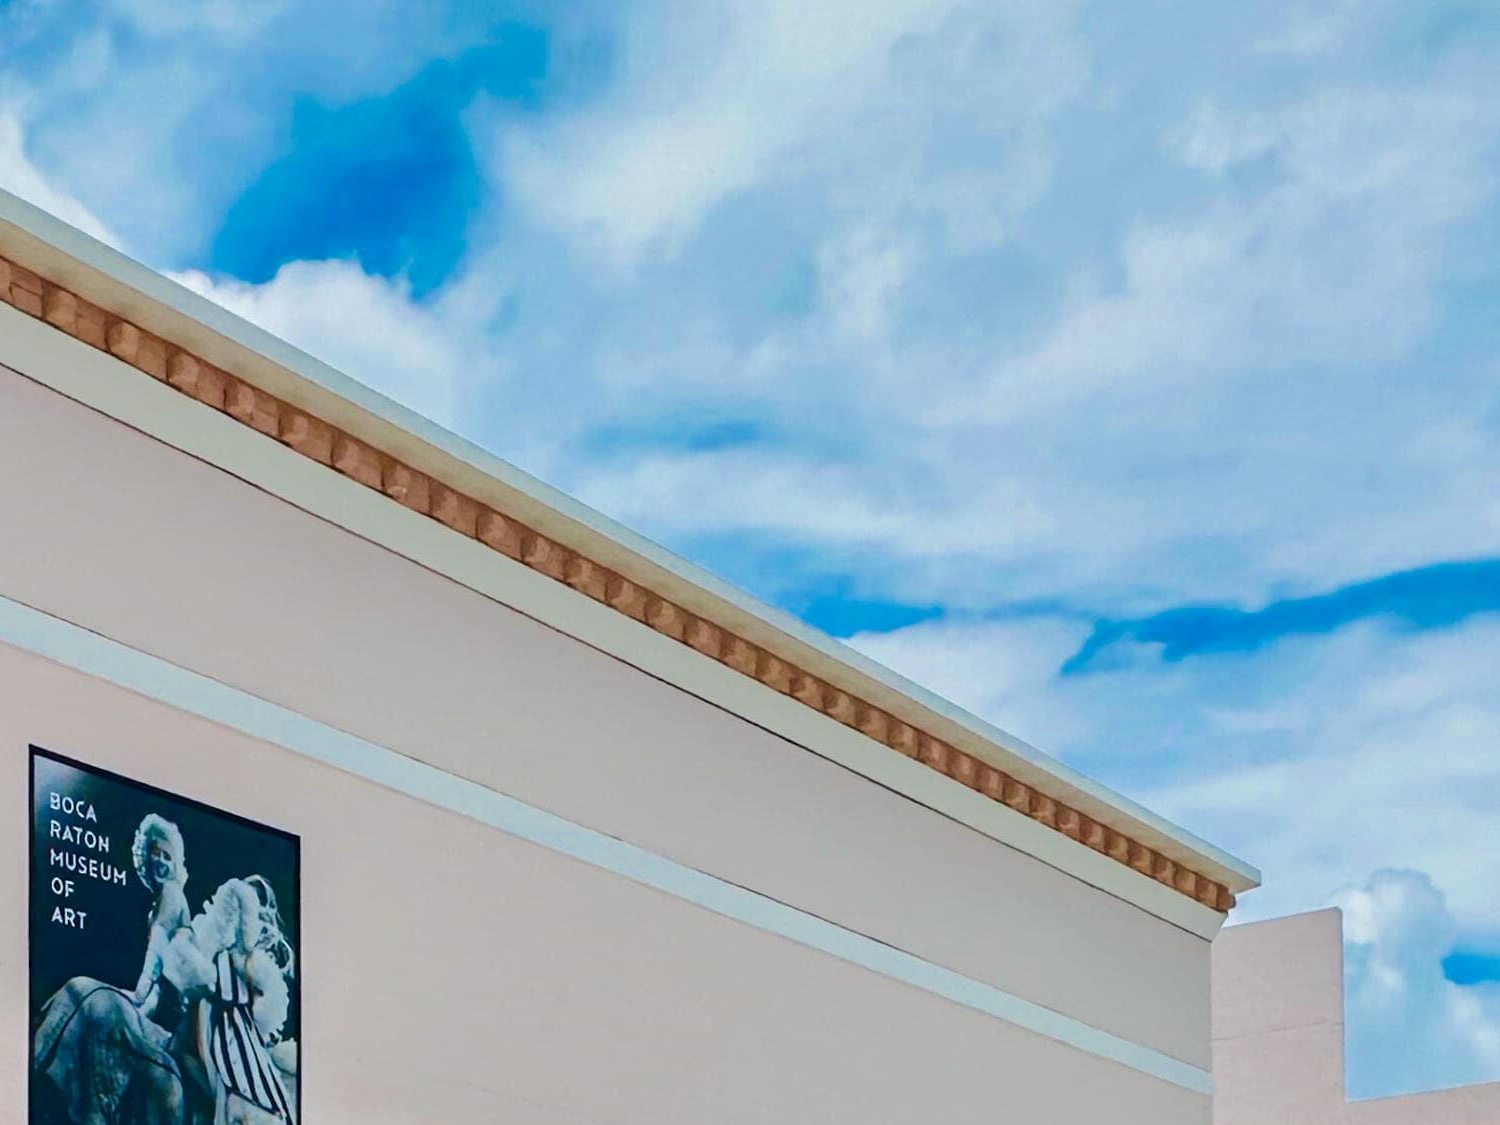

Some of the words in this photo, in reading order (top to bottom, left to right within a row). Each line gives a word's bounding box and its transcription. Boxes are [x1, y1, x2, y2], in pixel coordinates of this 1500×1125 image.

[50, 792, 97, 823] BOCA
[50, 820, 110, 852] RATON
[50, 848, 127, 886] MUSEUM
[51, 877, 75, 898] OF
[51, 906, 87, 929] ART
